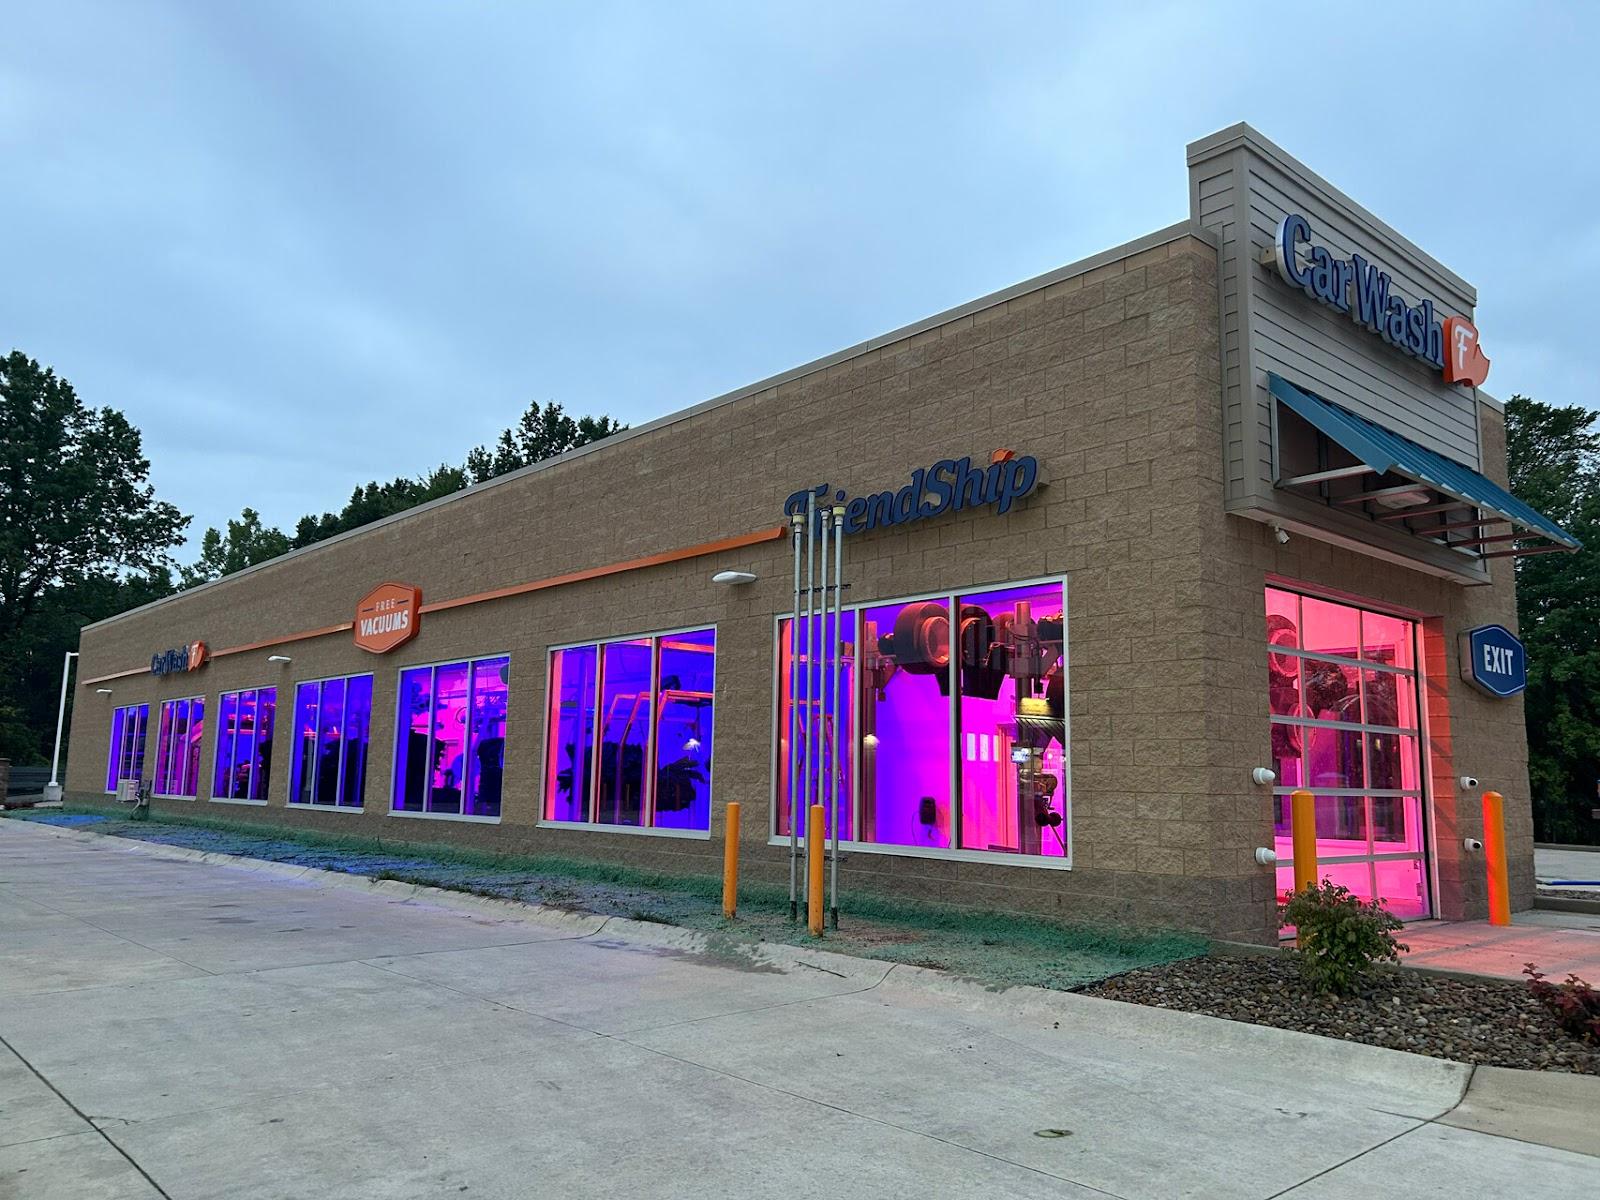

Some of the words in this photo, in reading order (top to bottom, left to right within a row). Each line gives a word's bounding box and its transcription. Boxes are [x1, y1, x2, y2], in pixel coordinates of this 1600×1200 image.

[1277, 213, 1444, 368] CarWash
[375, 598, 396, 612] FREE
[360, 609, 409, 637] VACUUMS
[1483, 644, 1514, 676] EXIT
